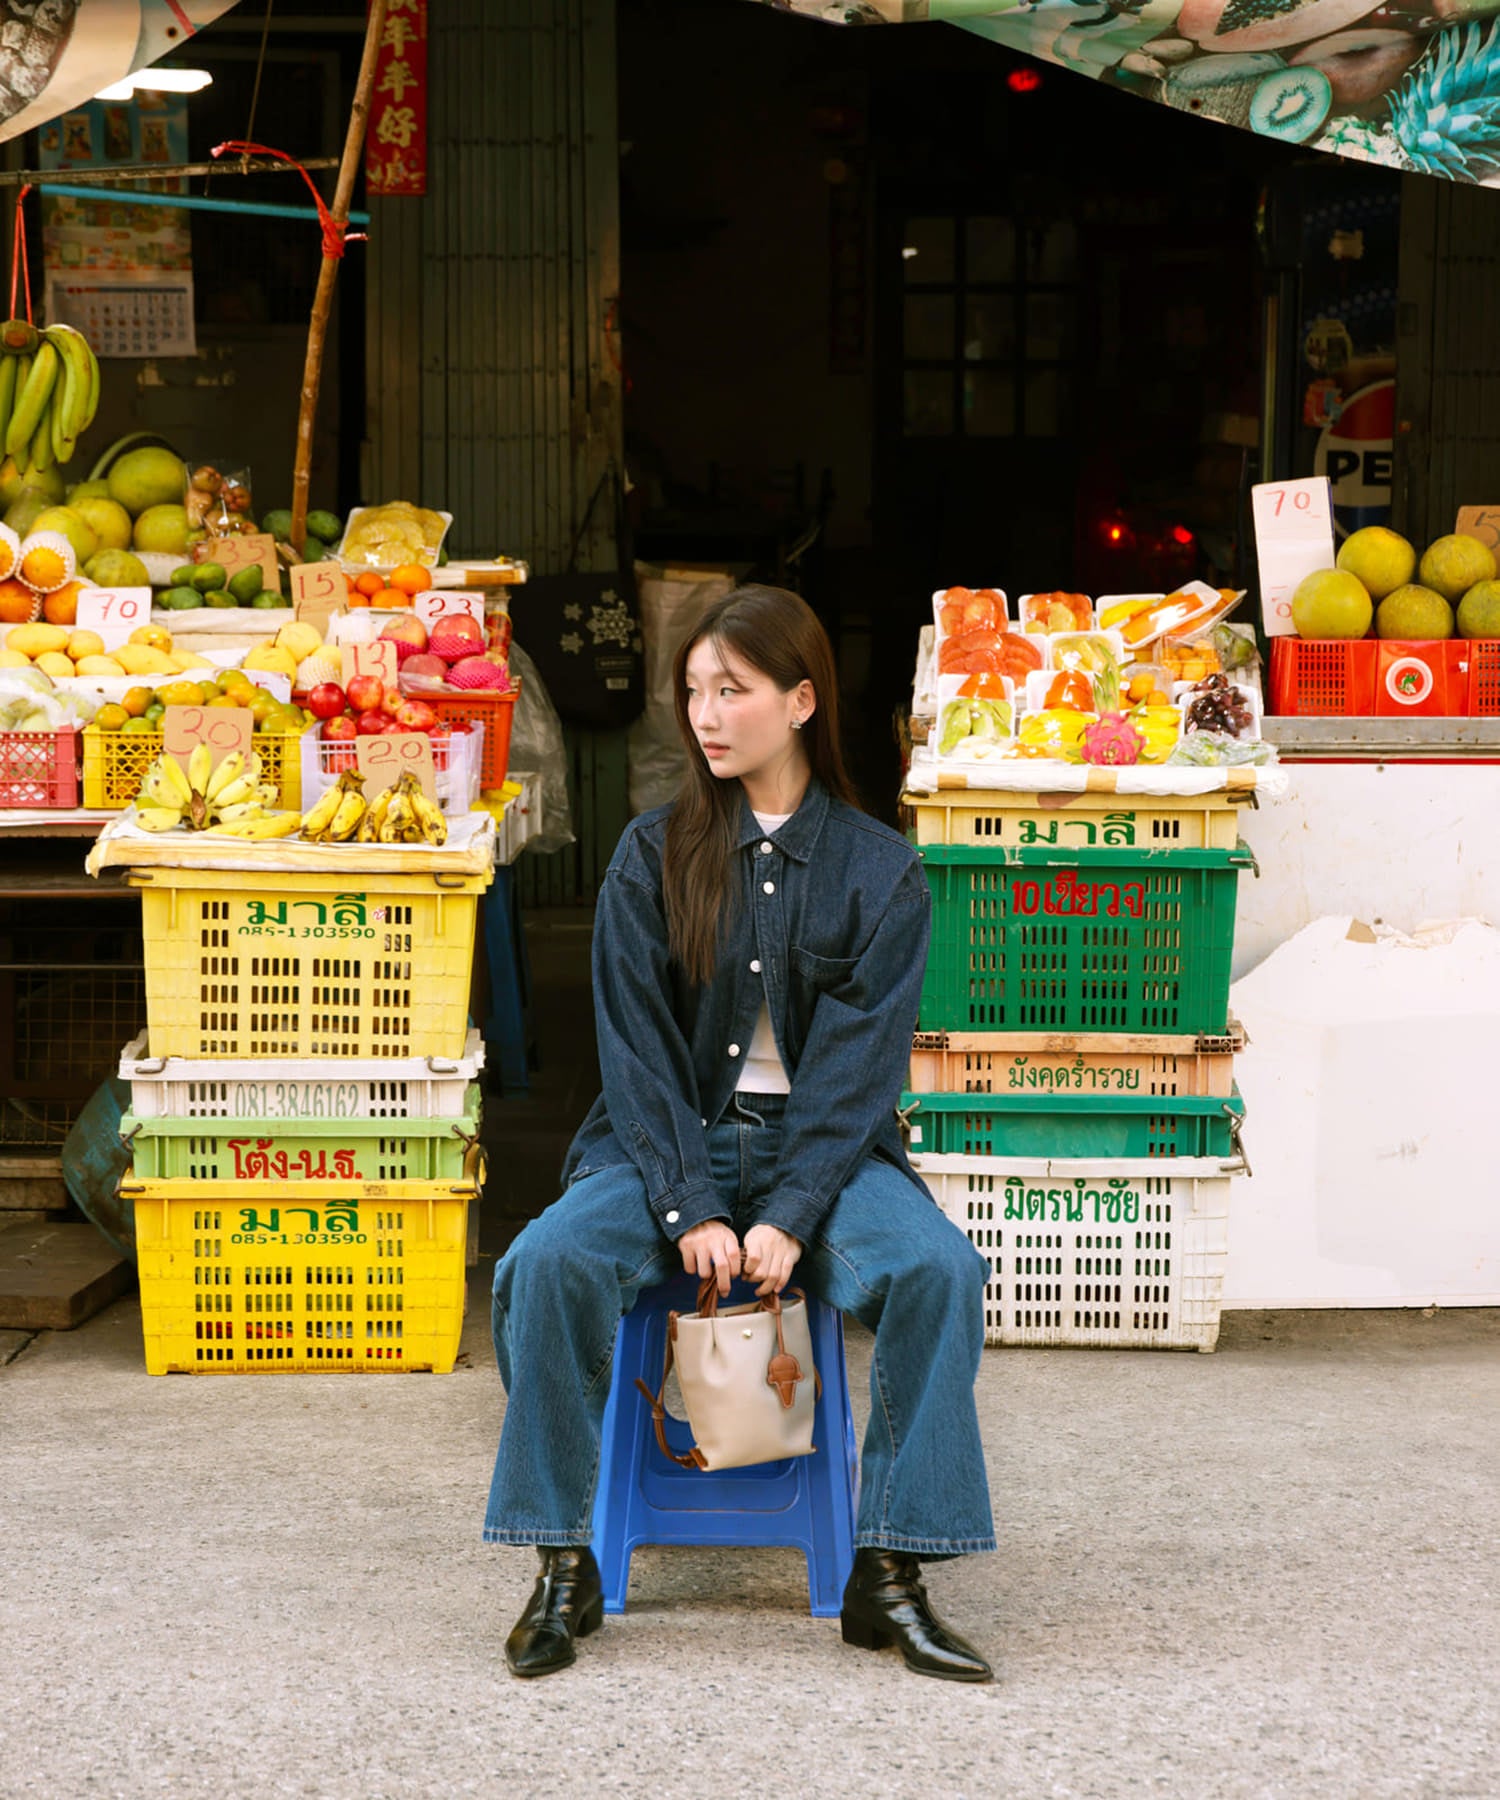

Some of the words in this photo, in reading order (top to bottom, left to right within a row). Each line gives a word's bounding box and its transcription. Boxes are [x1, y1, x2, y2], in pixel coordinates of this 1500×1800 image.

[219, 538, 266, 566] 35
[299, 571, 335, 600] 15
[91, 593, 138, 621] 70
[428, 597, 472, 617] 23
[352, 642, 387, 681] 13
[167, 707, 242, 755] 30
[367, 740, 424, 764] 20
[1018, 811, 1136, 846] มาลี
[246, 892, 367, 926] มาลี
[238, 926, 376, 939] 085-1303590
[1008, 1053, 1140, 1093] มังคุดร่ำรวย
[235, 1083, 359, 1117] 081-3846162
[239, 1199, 359, 1232] มาลี
[1004, 1176, 1140, 1223] มิตรนำชัย
[231, 1233, 367, 1245] 085-1303590
